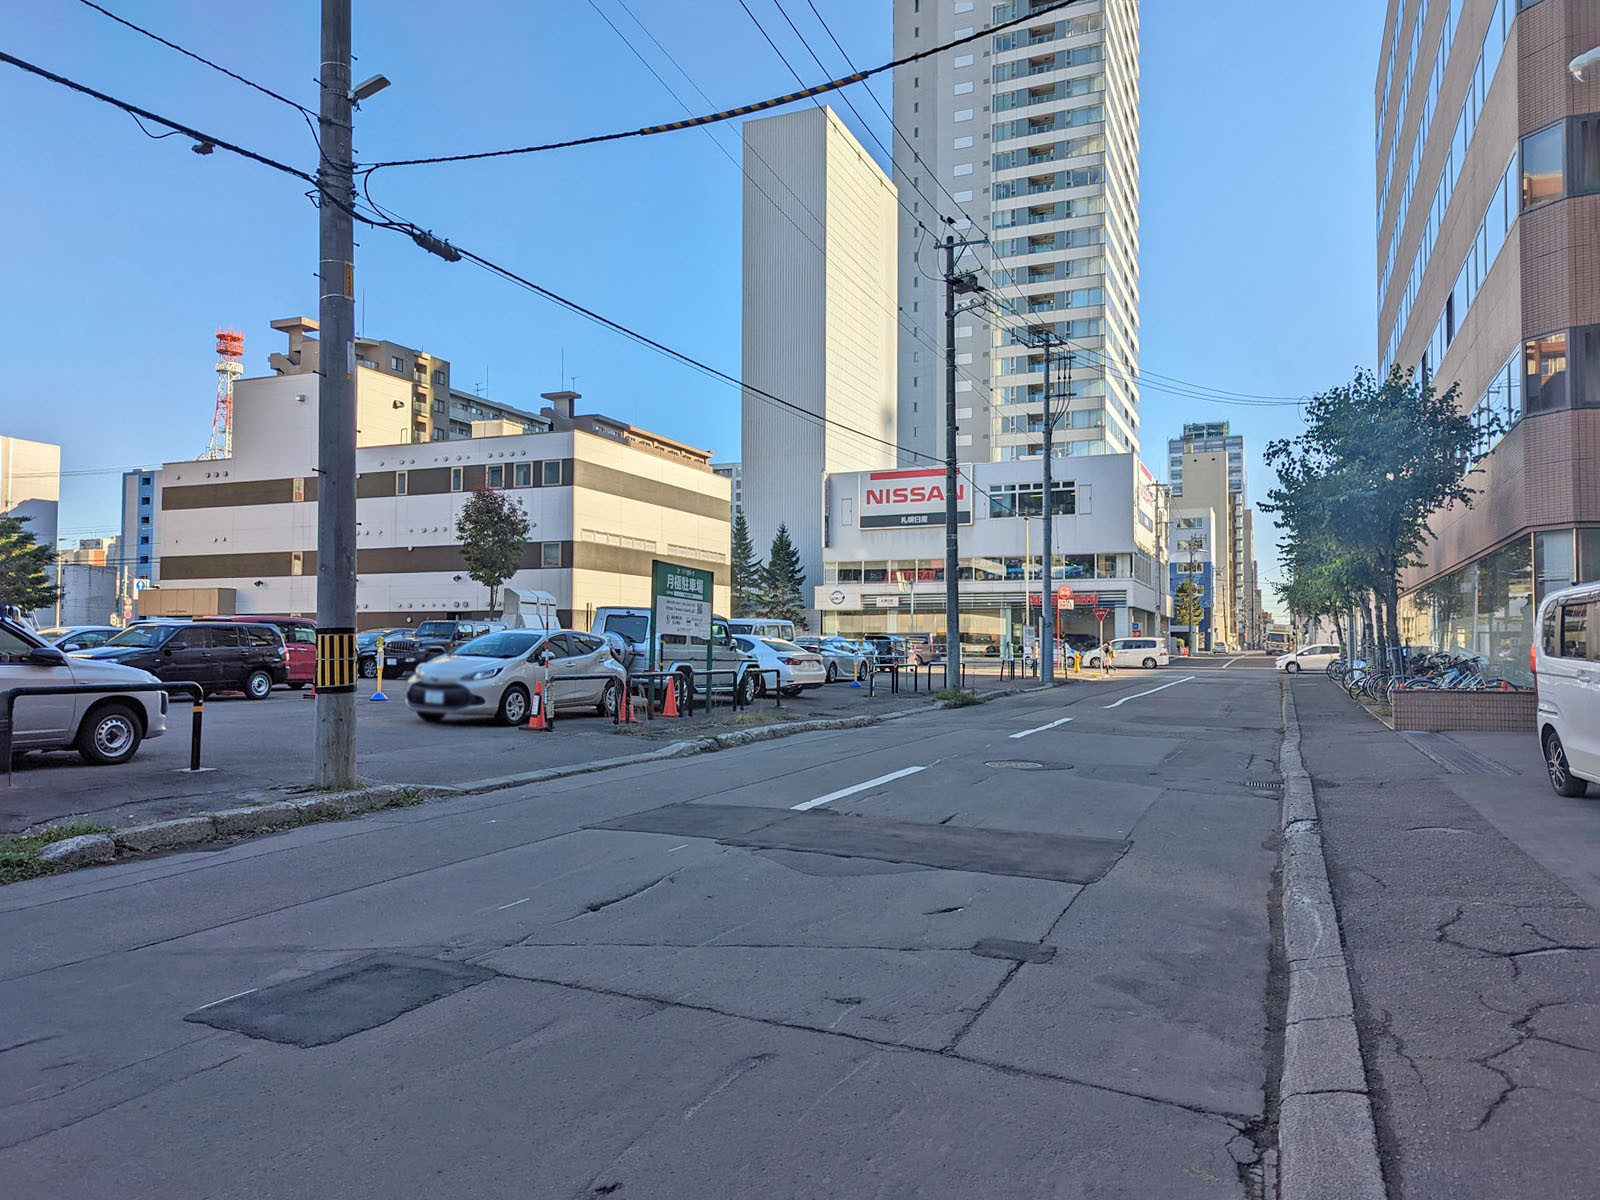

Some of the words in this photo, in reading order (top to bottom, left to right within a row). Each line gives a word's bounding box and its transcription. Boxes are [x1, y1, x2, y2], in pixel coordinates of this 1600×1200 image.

[901, 515, 928, 524] 札幌日産
[667, 574, 704, 594] 月極駐車場
[1029, 594, 1099, 606] NSAN
